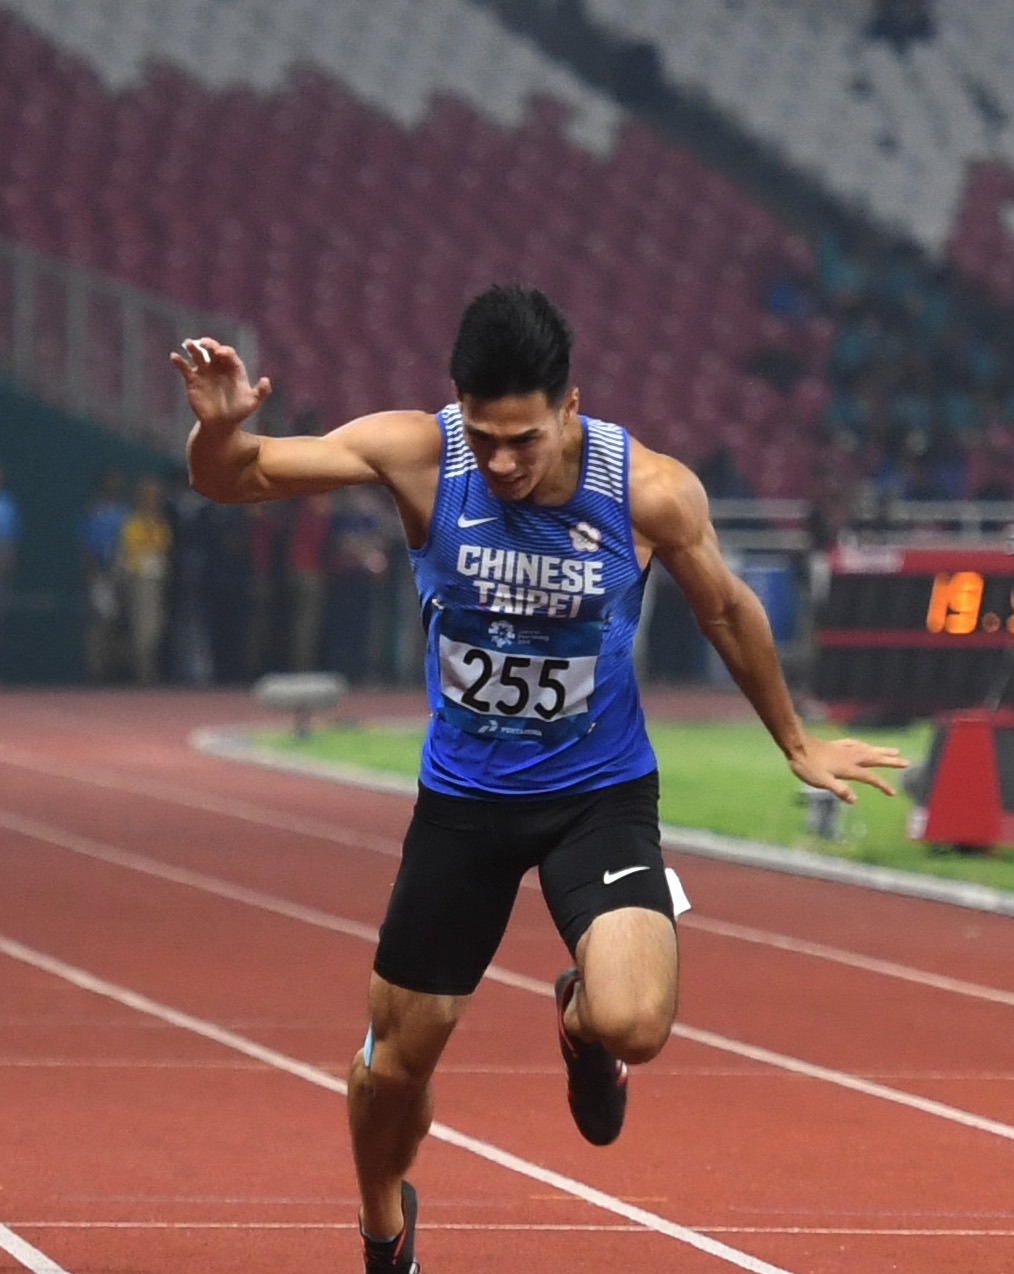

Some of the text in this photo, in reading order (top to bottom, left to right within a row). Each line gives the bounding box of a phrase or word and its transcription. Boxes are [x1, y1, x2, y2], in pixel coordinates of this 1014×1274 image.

[456, 544, 605, 595] CHINESE
[473, 580, 583, 619] TAIPEI
[460, 649, 570, 720] 255
